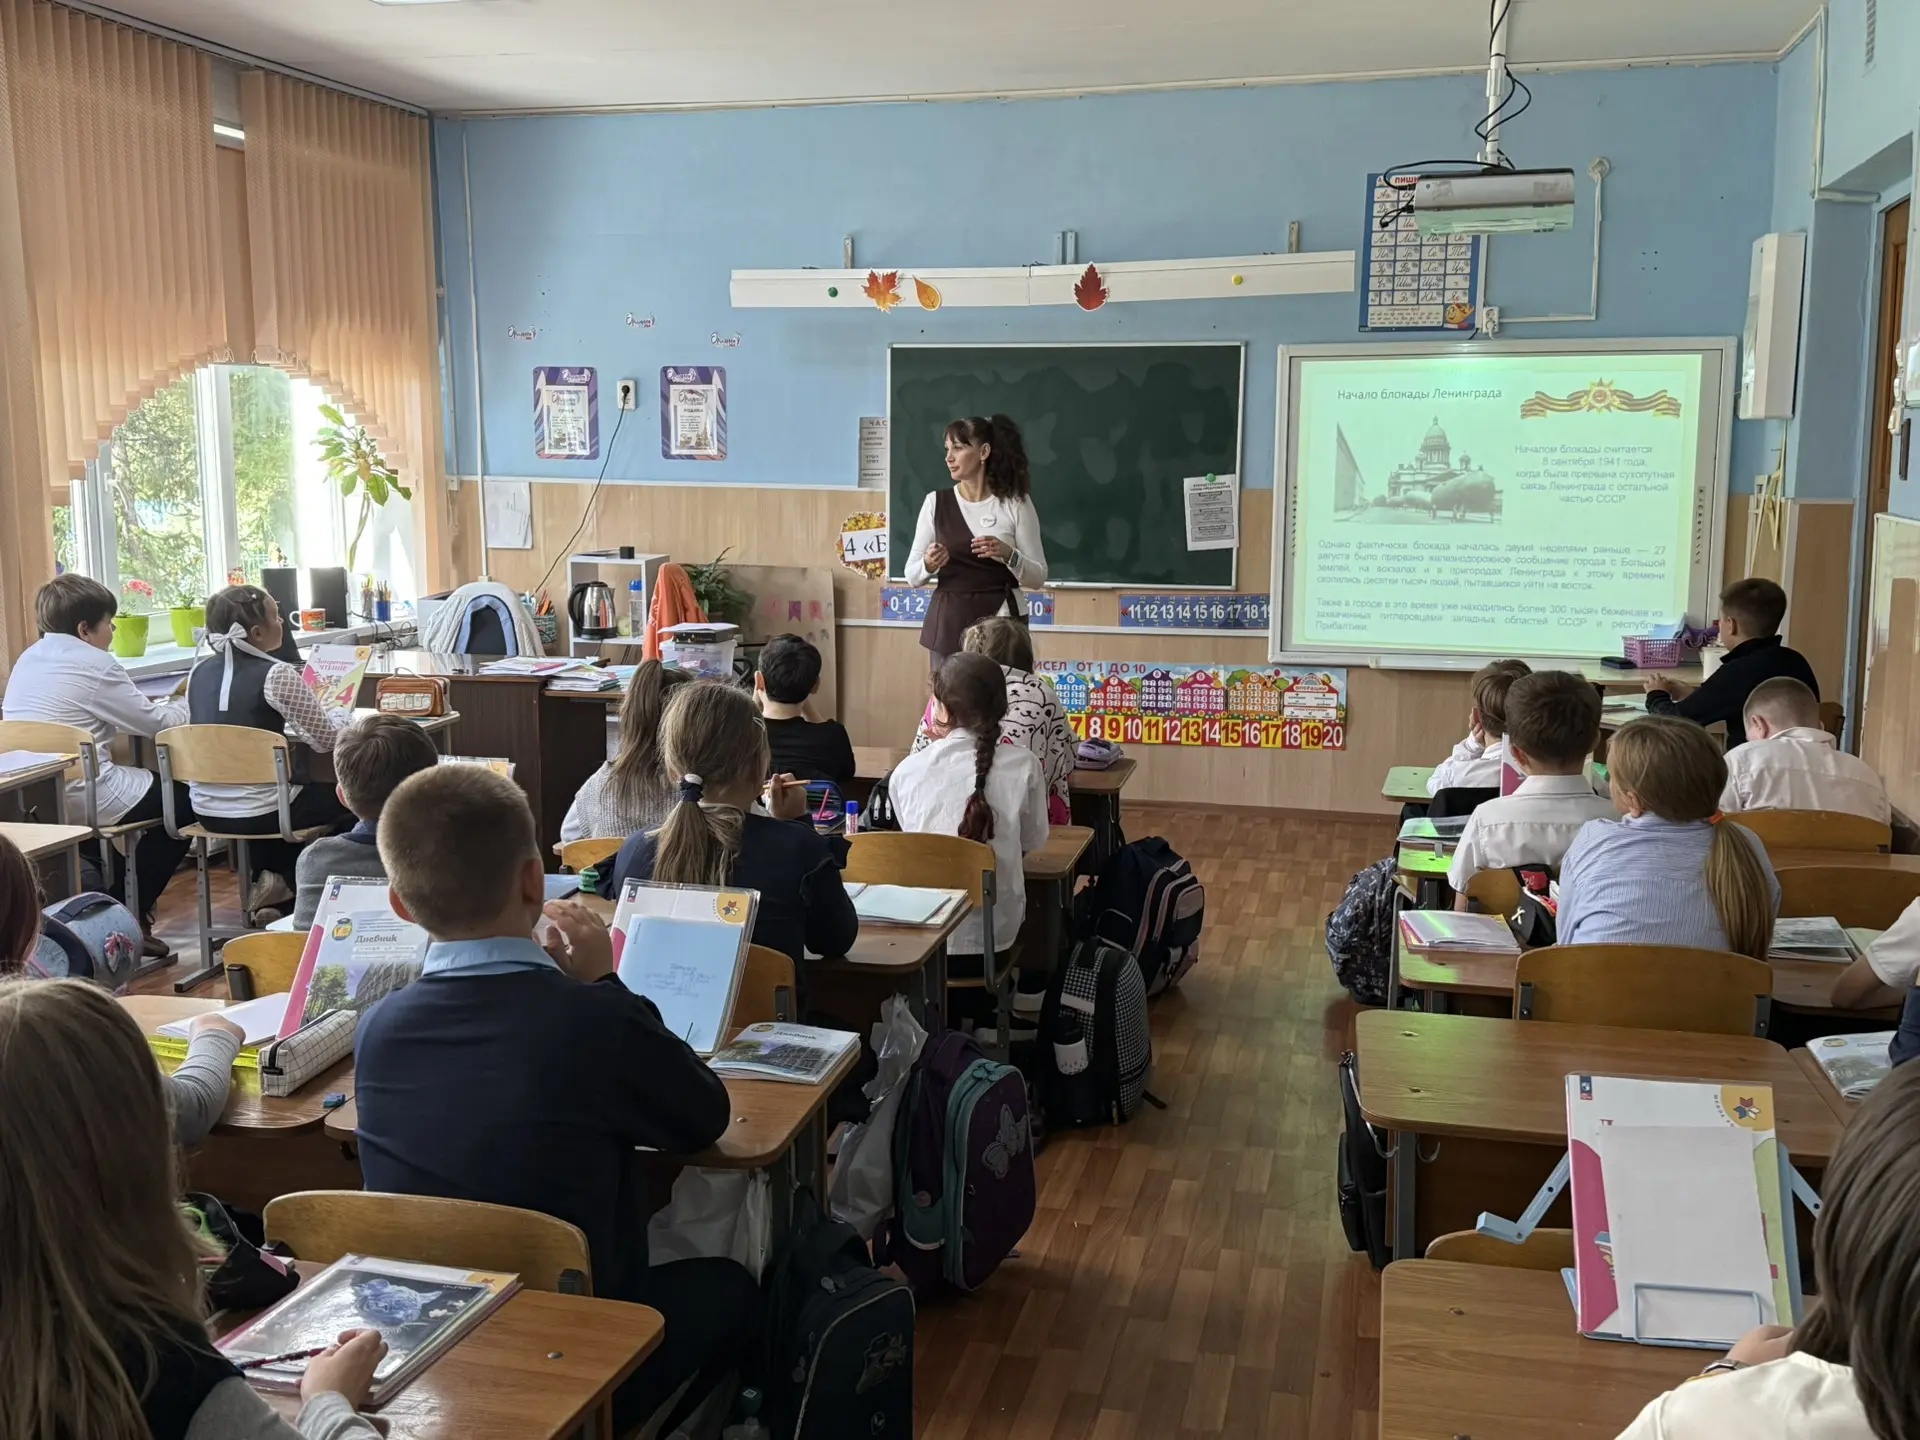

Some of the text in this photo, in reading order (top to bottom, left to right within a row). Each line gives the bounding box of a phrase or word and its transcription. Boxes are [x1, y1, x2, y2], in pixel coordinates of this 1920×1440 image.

[1338, 388, 1502, 402] Начало блокады Ленинграда
[1515, 445, 1557, 454] Началом
[1559, 445, 1601, 455] блокады
[1542, 457, 1647, 467] 8 сентября 1941 года,
[1516, 469, 1675, 481] когда была прервана сухопутная
[1520, 483, 1547, 491] связь
[1549, 481, 1606, 492] Ленинграда
[1617, 482, 1668, 492] остальной
[1559, 494, 1626, 503] частью СССР
[845, 537, 856, 555] 4
[1318, 539, 1351, 549] Однако
[1413, 540, 1450, 550] блокада
[1505, 543, 1534, 553] двумя
[1540, 544, 1587, 552] неделями
[1593, 545, 1630, 554] раньше
[1653, 545, 1667, 554] 27
[1317, 553, 1350, 561] августа
[1354, 553, 1378, 561] было
[1382, 554, 1424, 563] прервано
[1573, 558, 1606, 566] города
[1621, 557, 1666, 567] Большой
[1450, 568, 1502, 576] пригородах
[1510, 567, 1566, 577] Ленинграда
[1586, 570, 1615, 580] этому
[1622, 571, 1665, 580] времени
[1523, 579, 1544, 589] уйти
[890, 596, 924, 612] 0 1 2
[1027, 601, 1043, 616] 10
[1317, 597, 1342, 606] Также
[1353, 600, 1382, 608] городе
[1410, 601, 1438, 610] время
[1441, 602, 1458, 610] уже
[1461, 604, 1515, 612] находились
[1518, 603, 1546, 613] более
[1549, 604, 1567, 613] 300
[1128, 604, 1141, 619] 11
[1144, 604, 1157, 619] 12
[1160, 604, 1174, 619] 13
[1176, 604, 1191, 619] 14
[1193, 604, 1207, 619] 15
[1210, 604, 1224, 619] 16
[1227, 604, 1242, 619] 17
[1244, 604, 1258, 619] 18
[1504, 615, 1548, 625] областей
[1557, 617, 1588, 627] СССР
[1076, 662, 1093, 672] ОТ
[1097, 663, 1103, 672] 1
[1108, 663, 1130, 675] ДО
[1133, 663, 1146, 674] 10
[335, 683, 356, 705] 4
[1070, 716, 1343, 747] 7 8 9 10 11 12 13 14 15 16 17 18 19 20
[354, 934, 397, 944] Дневник
[774, 1031, 817, 1040] Дневник
